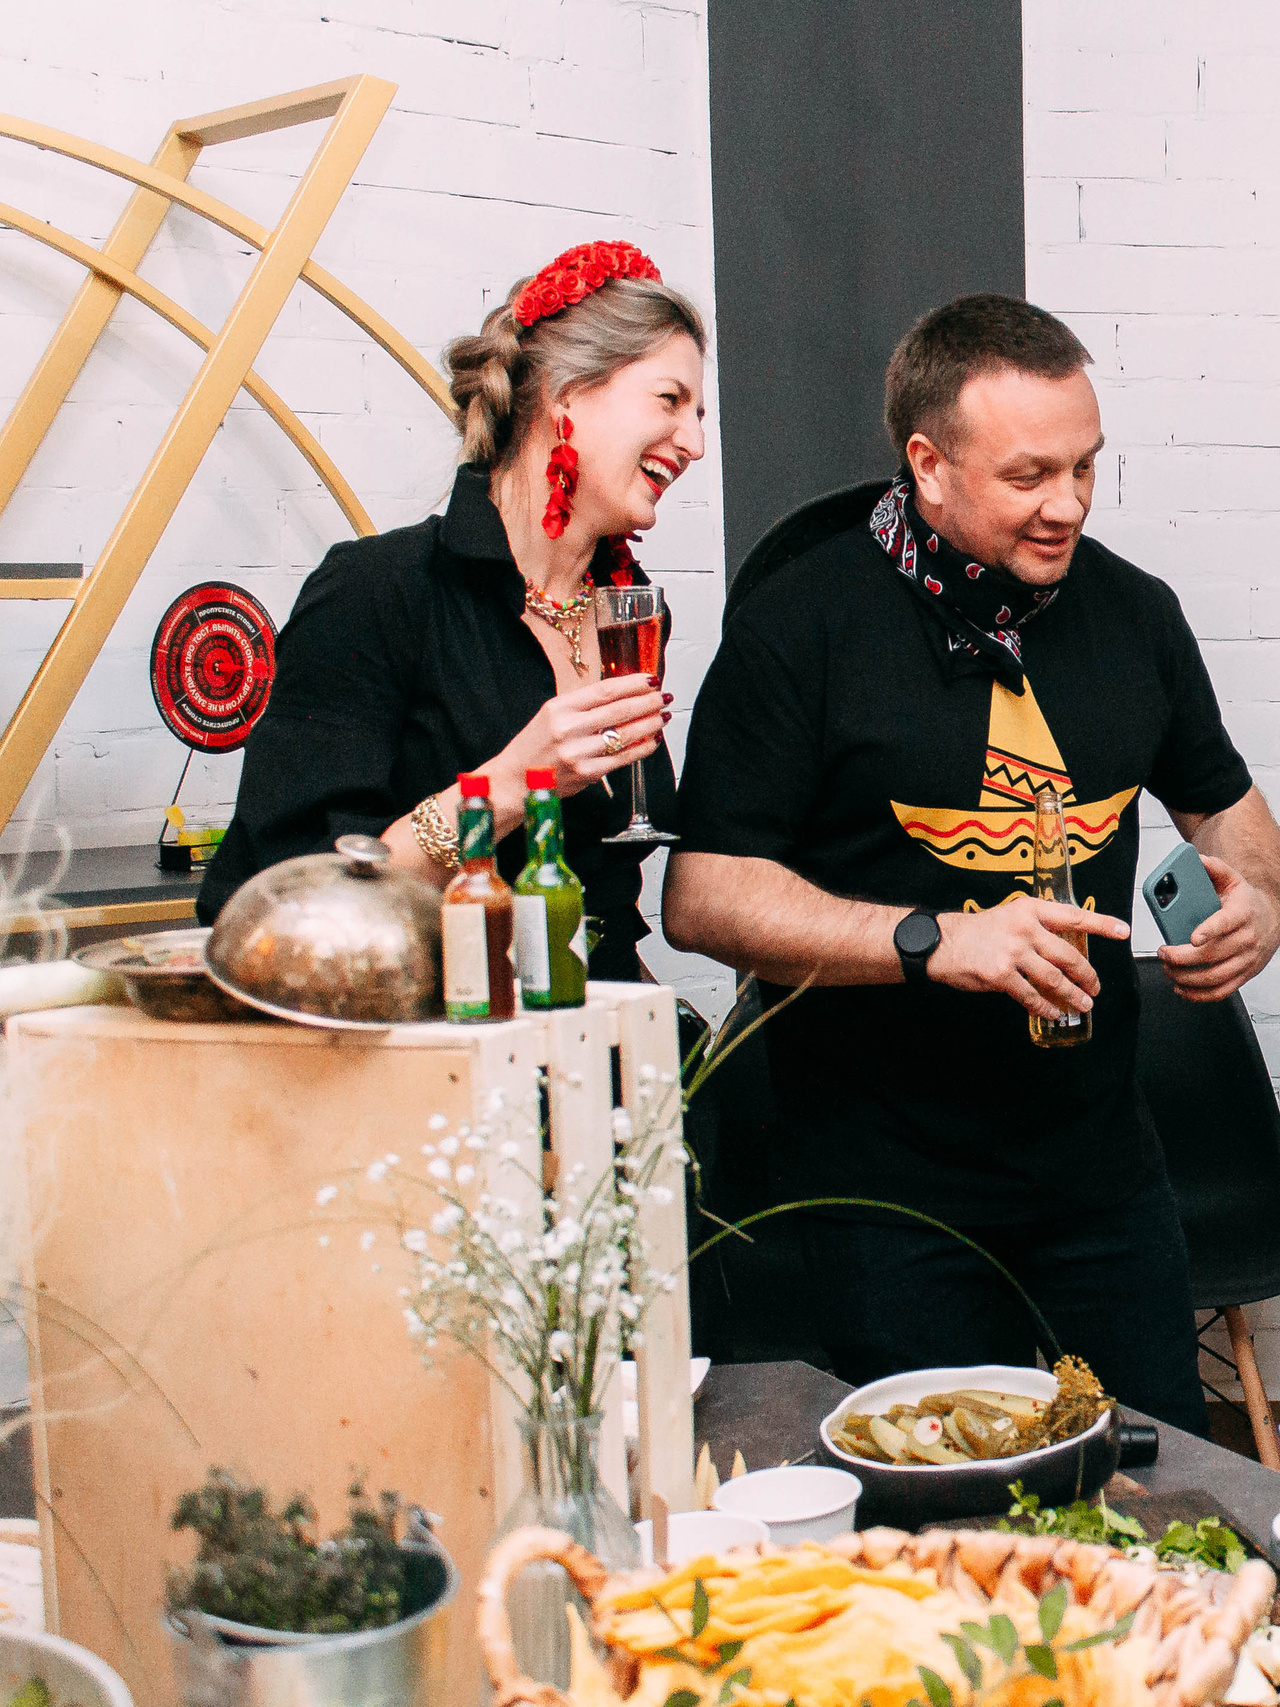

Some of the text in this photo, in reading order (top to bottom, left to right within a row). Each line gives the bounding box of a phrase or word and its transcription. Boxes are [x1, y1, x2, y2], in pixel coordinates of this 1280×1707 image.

[198, 607, 236, 617] ПРОПУСТИТЕ
[212, 623, 240, 639] ВЫПИТЬ
[184, 644, 195, 663] ПРО
[184, 665, 207, 707] ЗАБУДЬТЕ
[225, 682, 250, 710] ДРУГОМ
[207, 702, 217, 711] НЕ
